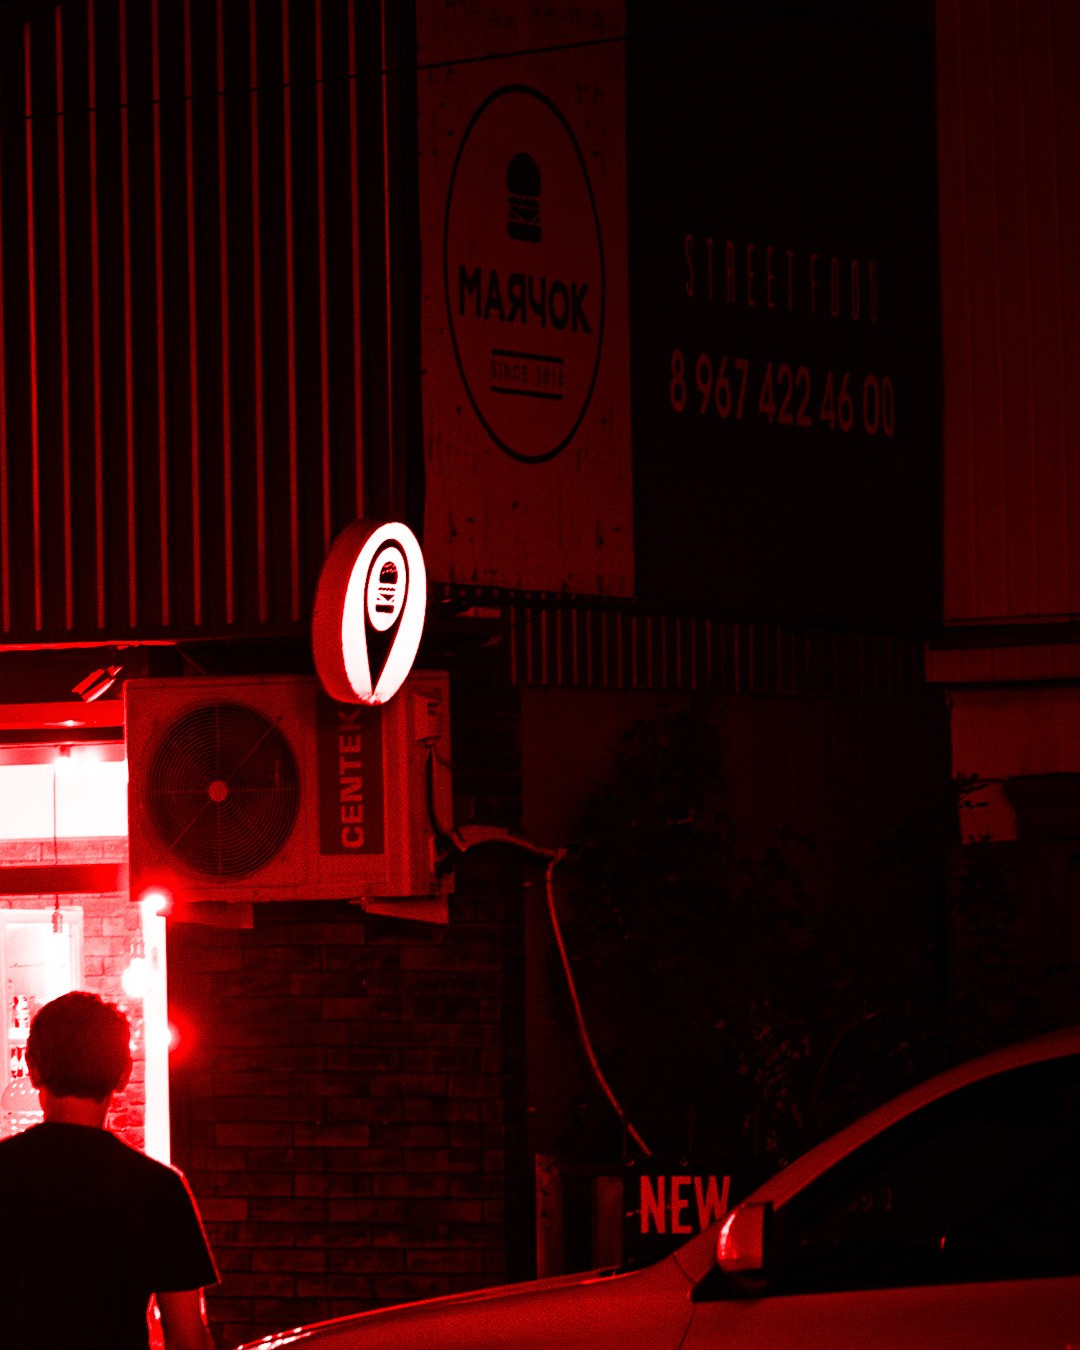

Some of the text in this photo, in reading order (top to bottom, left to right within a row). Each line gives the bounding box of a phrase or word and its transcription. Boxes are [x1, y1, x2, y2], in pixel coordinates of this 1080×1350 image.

[458, 264, 591, 334] МАЯЧОК
[684, 233, 796, 311] STREET
[669, 347, 897, 438] 8 967 422 46 00
[338, 704, 364, 849] CENTEK
[639, 1175, 732, 1235] NEW
